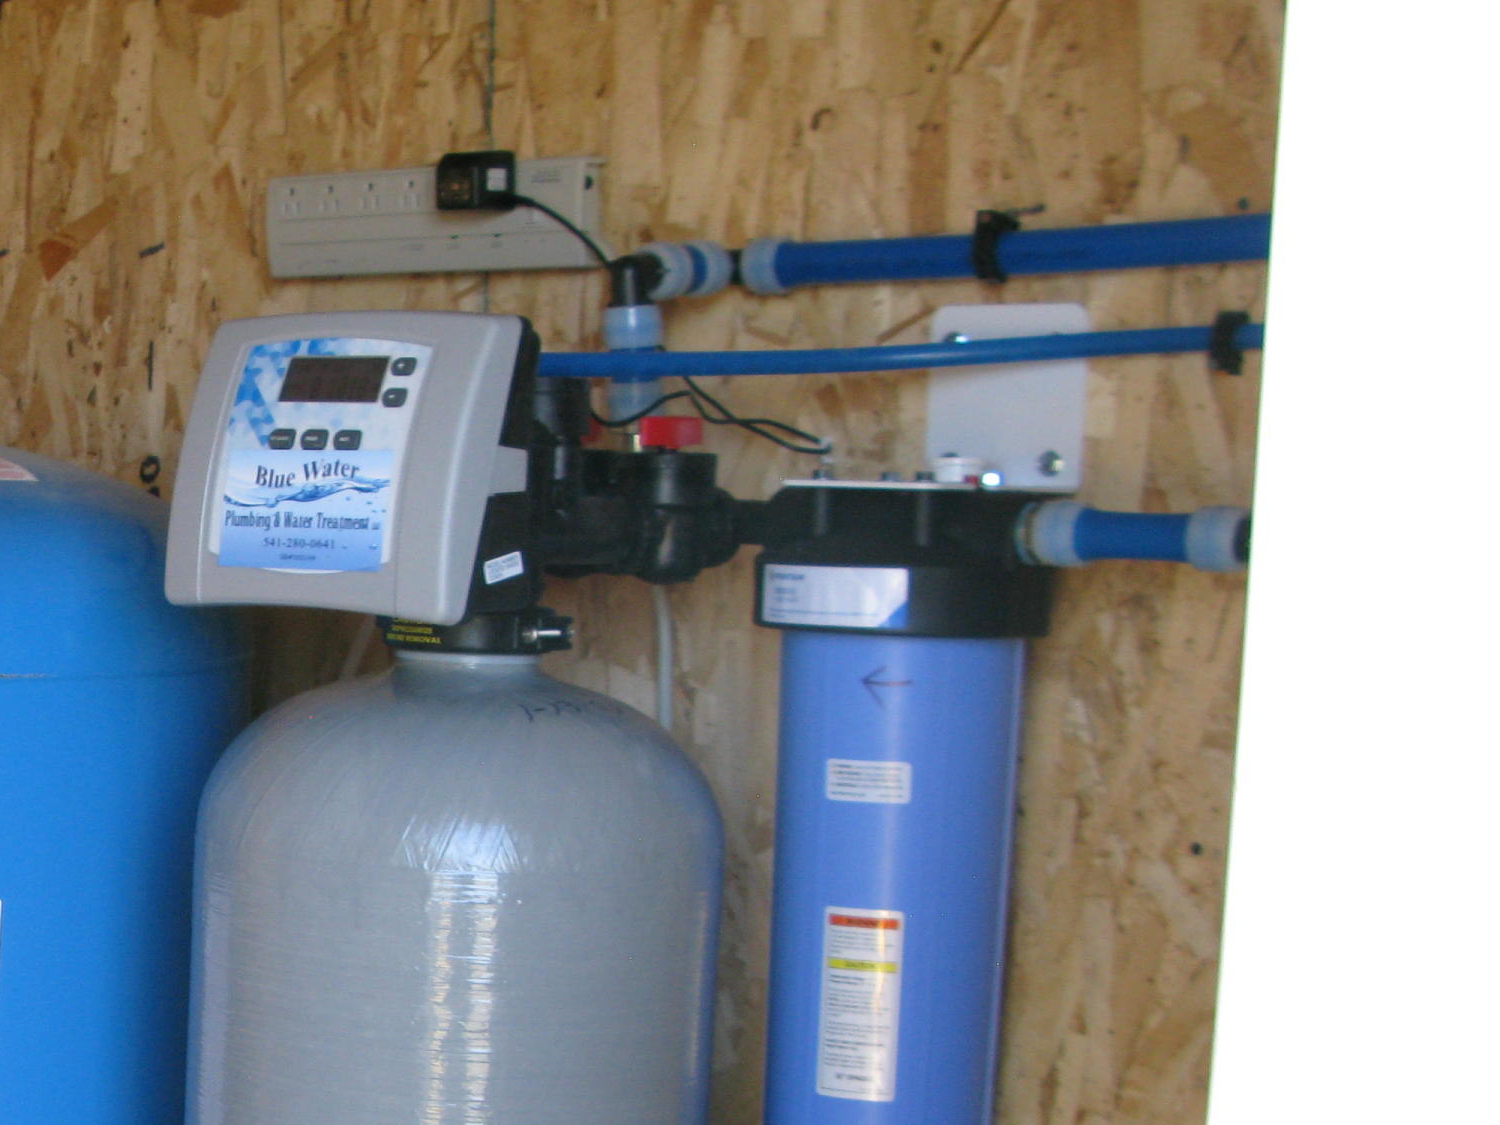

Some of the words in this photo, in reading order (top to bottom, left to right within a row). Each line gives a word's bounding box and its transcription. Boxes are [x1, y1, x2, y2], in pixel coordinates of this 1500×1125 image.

[256, 465, 295, 488] Blue
[303, 459, 360, 481] Water
[225, 510, 271, 531] Plumbing
[284, 512, 313, 528] Water
[317, 512, 369, 530] Treatment
